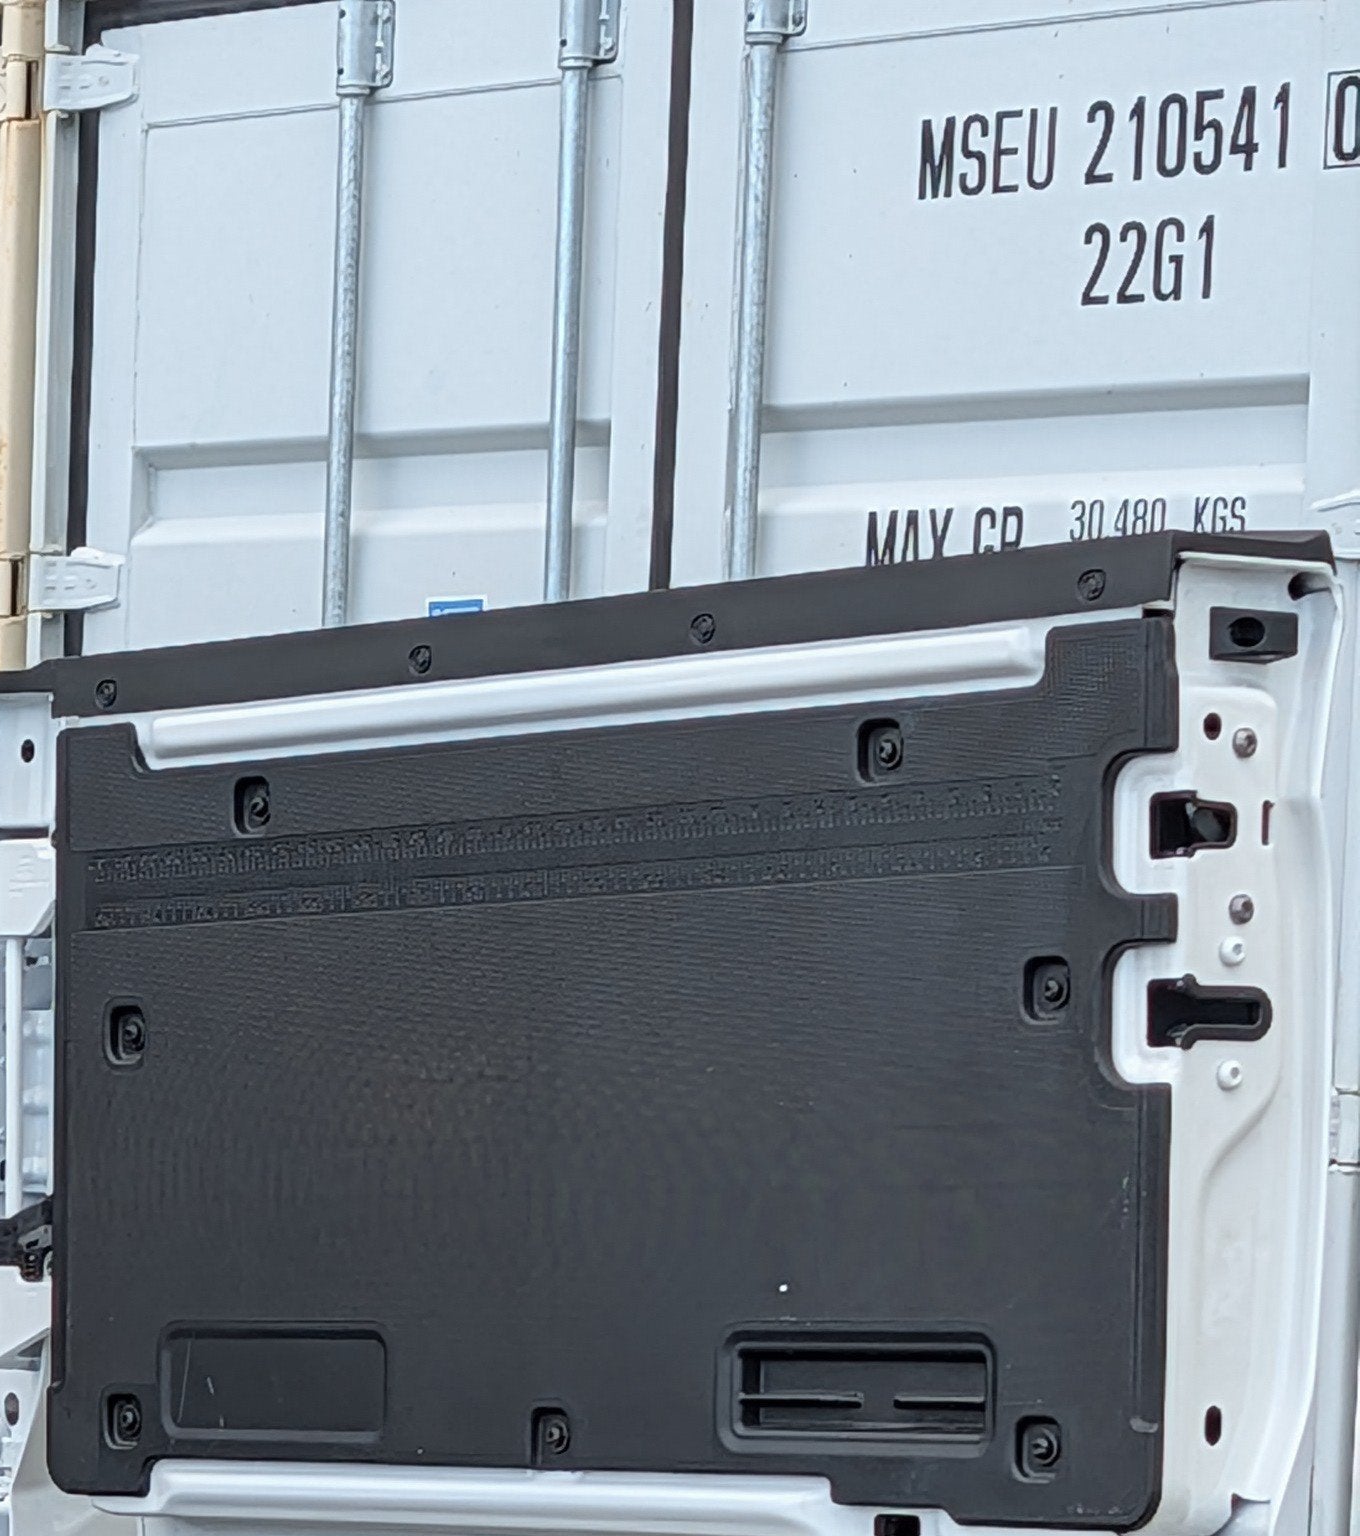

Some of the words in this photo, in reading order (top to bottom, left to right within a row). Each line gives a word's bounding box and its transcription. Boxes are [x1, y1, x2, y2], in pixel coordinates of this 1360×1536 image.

[917, 106, 1058, 200] MSEU
[1083, 81, 1291, 186] 210541
[1332, 75, 1360, 161] 0
[1081, 214, 1215, 306] 22G1
[1193, 496, 1247, 534] KGS
